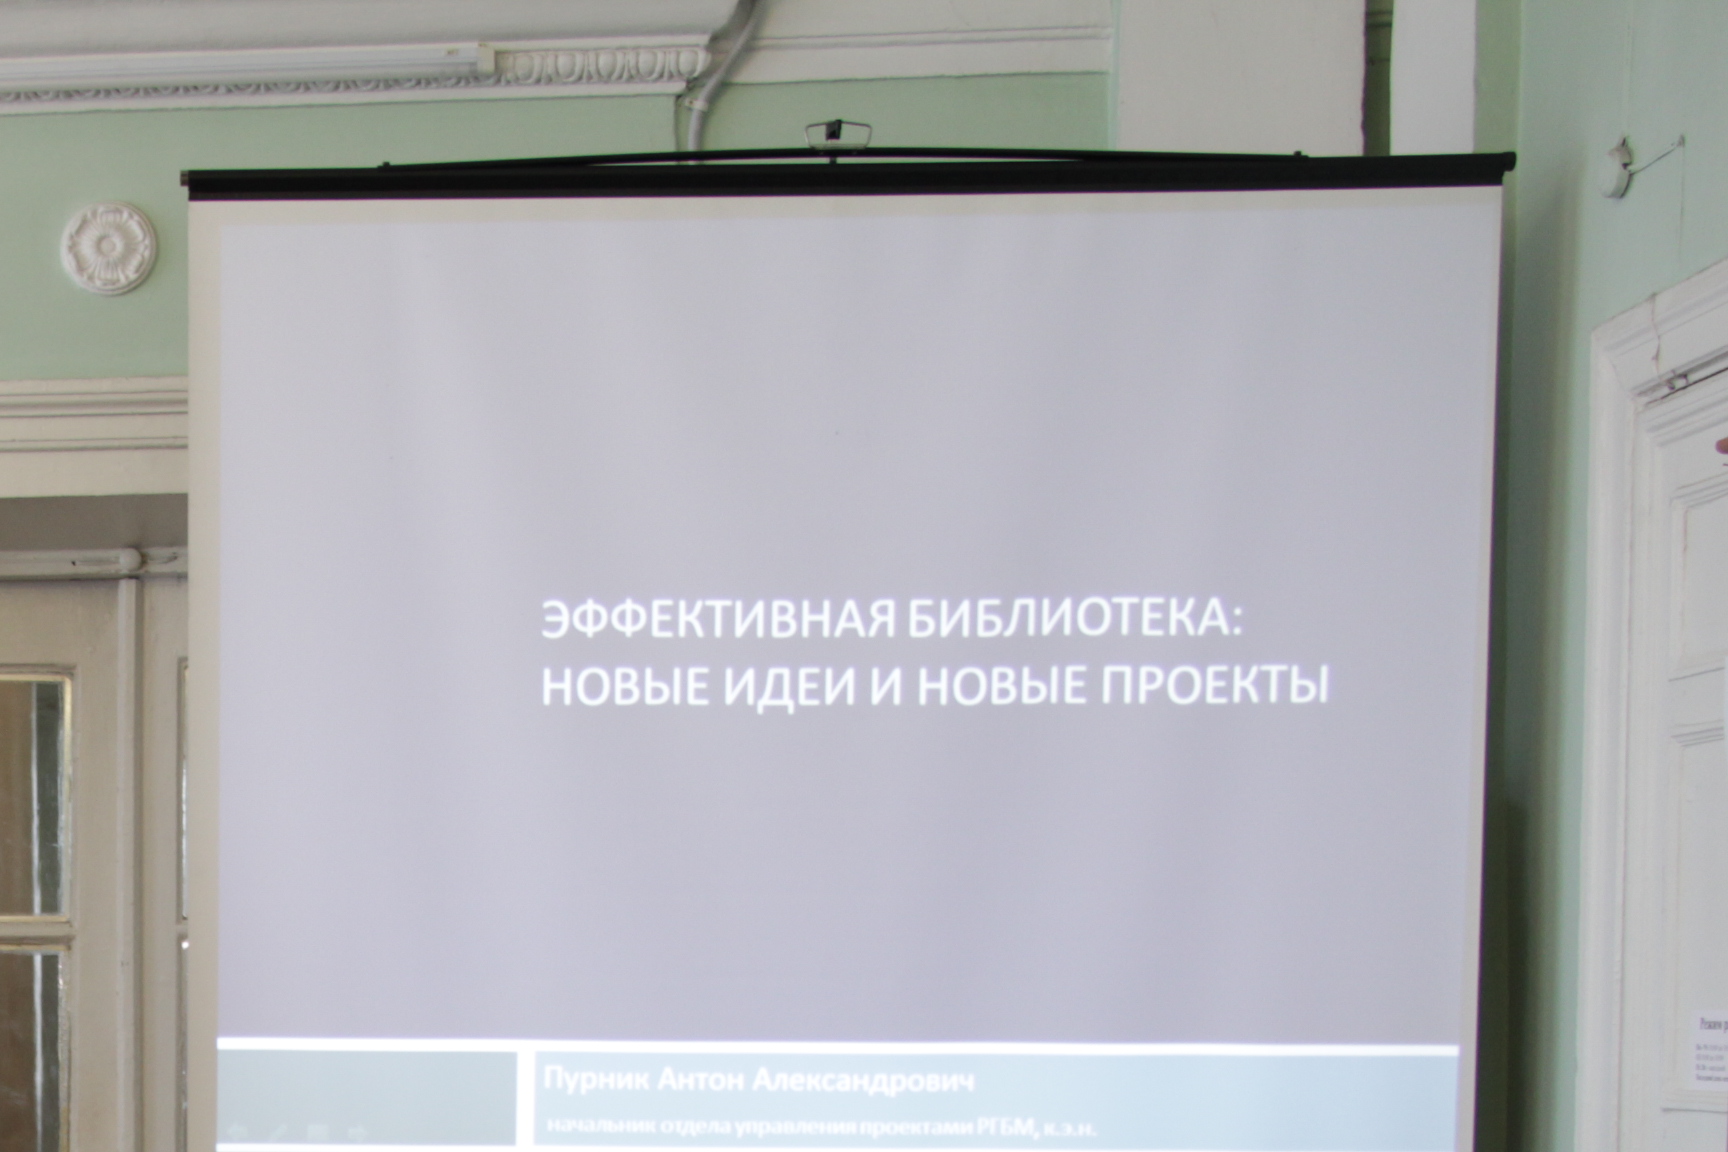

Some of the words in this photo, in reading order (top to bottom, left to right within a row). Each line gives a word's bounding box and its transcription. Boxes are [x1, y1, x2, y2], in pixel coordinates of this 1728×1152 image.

[542, 598, 896, 638] ЭФФЕКТИВНАЯ
[910, 596, 1243, 637] БИБЛИОТЕКА:
[543, 667, 709, 706] НОВЫЕ
[725, 667, 855, 715] ИДЕИ
[872, 667, 903, 706] И
[920, 665, 1087, 705] НОВЫЕ
[1103, 664, 1330, 704] ПРОЕКТЫ
[543, 1064, 650, 1095] Пурник
[657, 1066, 744, 1092] Антон
[751, 1066, 975, 1097] Александрович
[547, 1118, 657, 1134] начальник
[660, 1119, 732, 1137] отдела
[735, 1119, 857, 1138] управления
[860, 1120, 973, 1139] проектами
